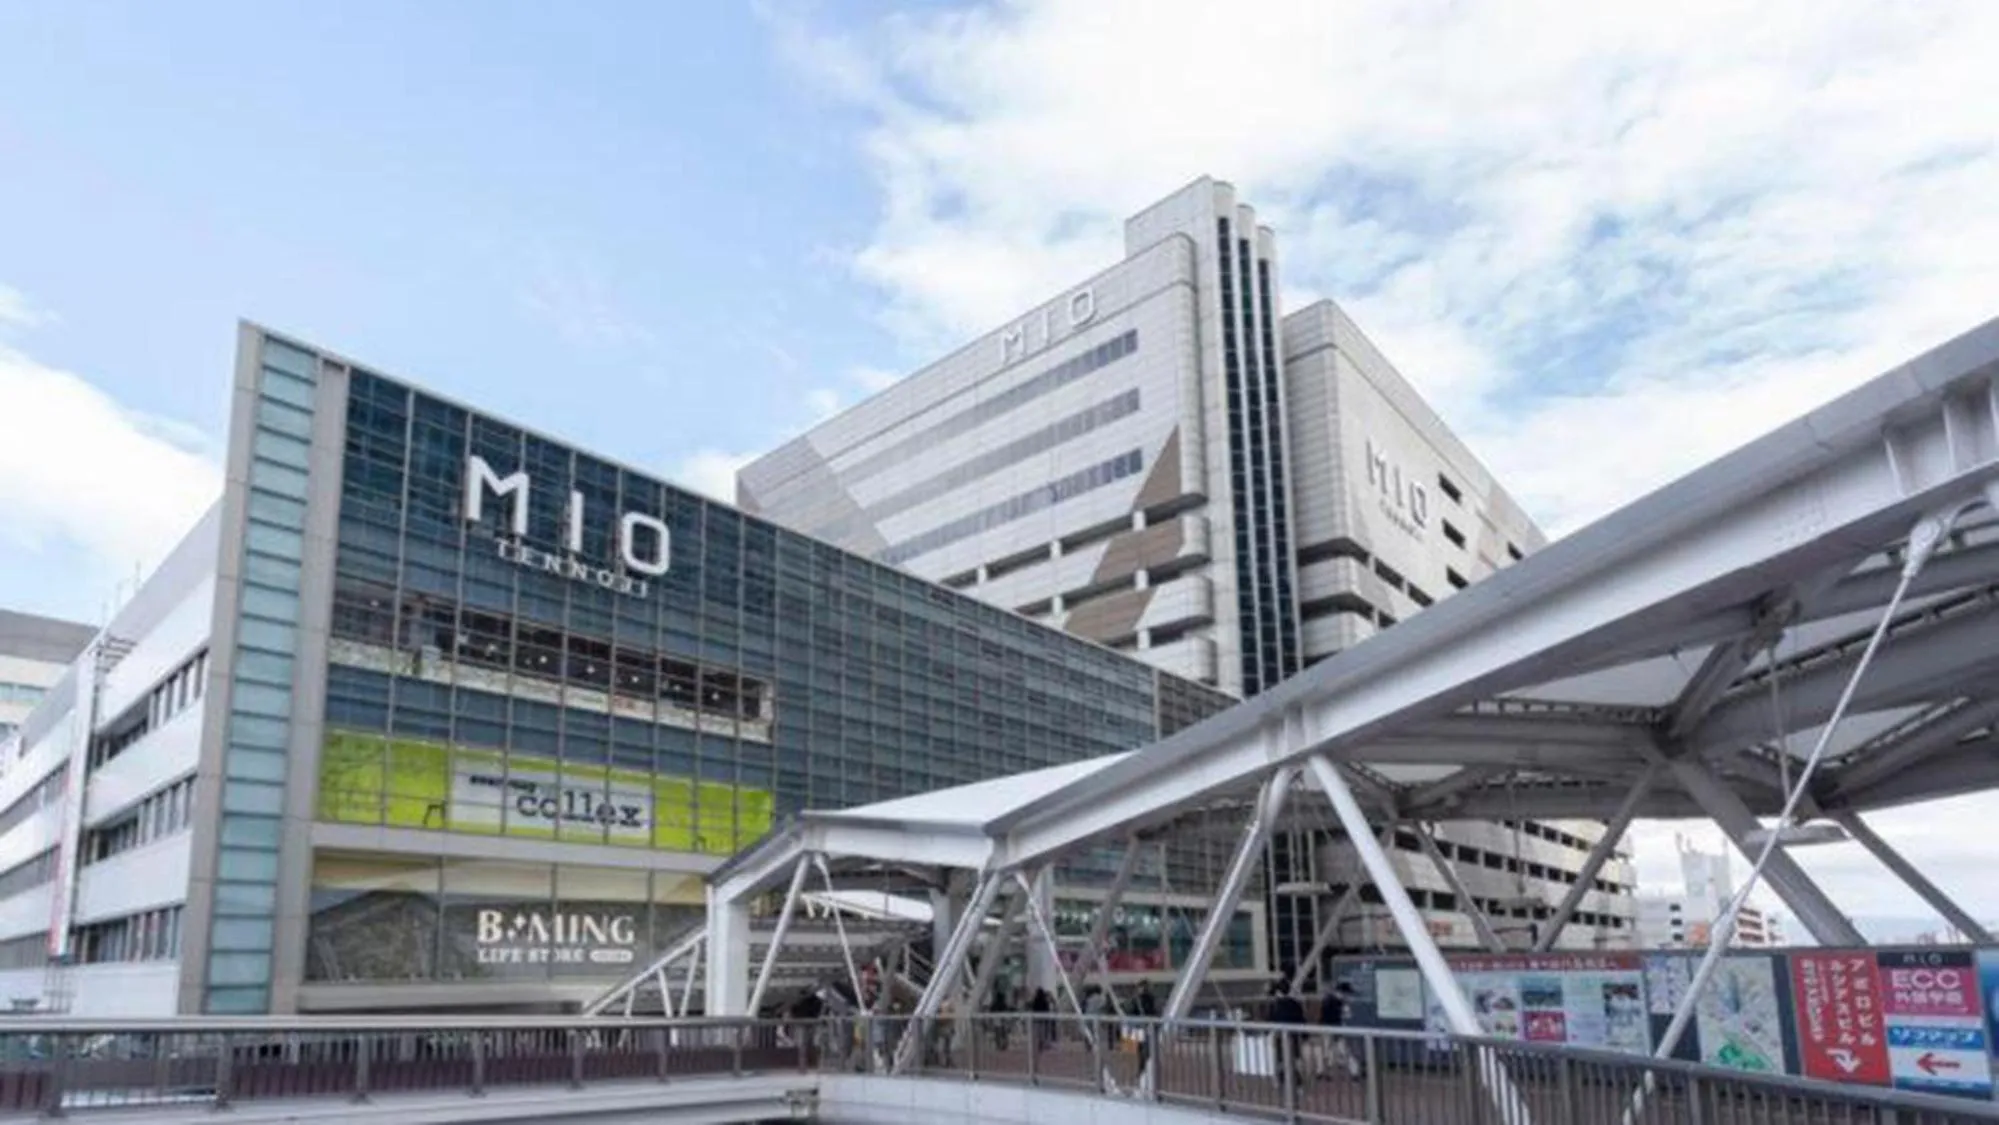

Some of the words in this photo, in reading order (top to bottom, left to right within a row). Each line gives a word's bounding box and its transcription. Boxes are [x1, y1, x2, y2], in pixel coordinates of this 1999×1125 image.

[1000, 286, 1095, 363] MIO
[465, 454, 671, 576] MIO
[1365, 434, 1428, 531] MIO
[516, 789, 641, 828] collex
[1892, 968, 1961, 990] ECC
